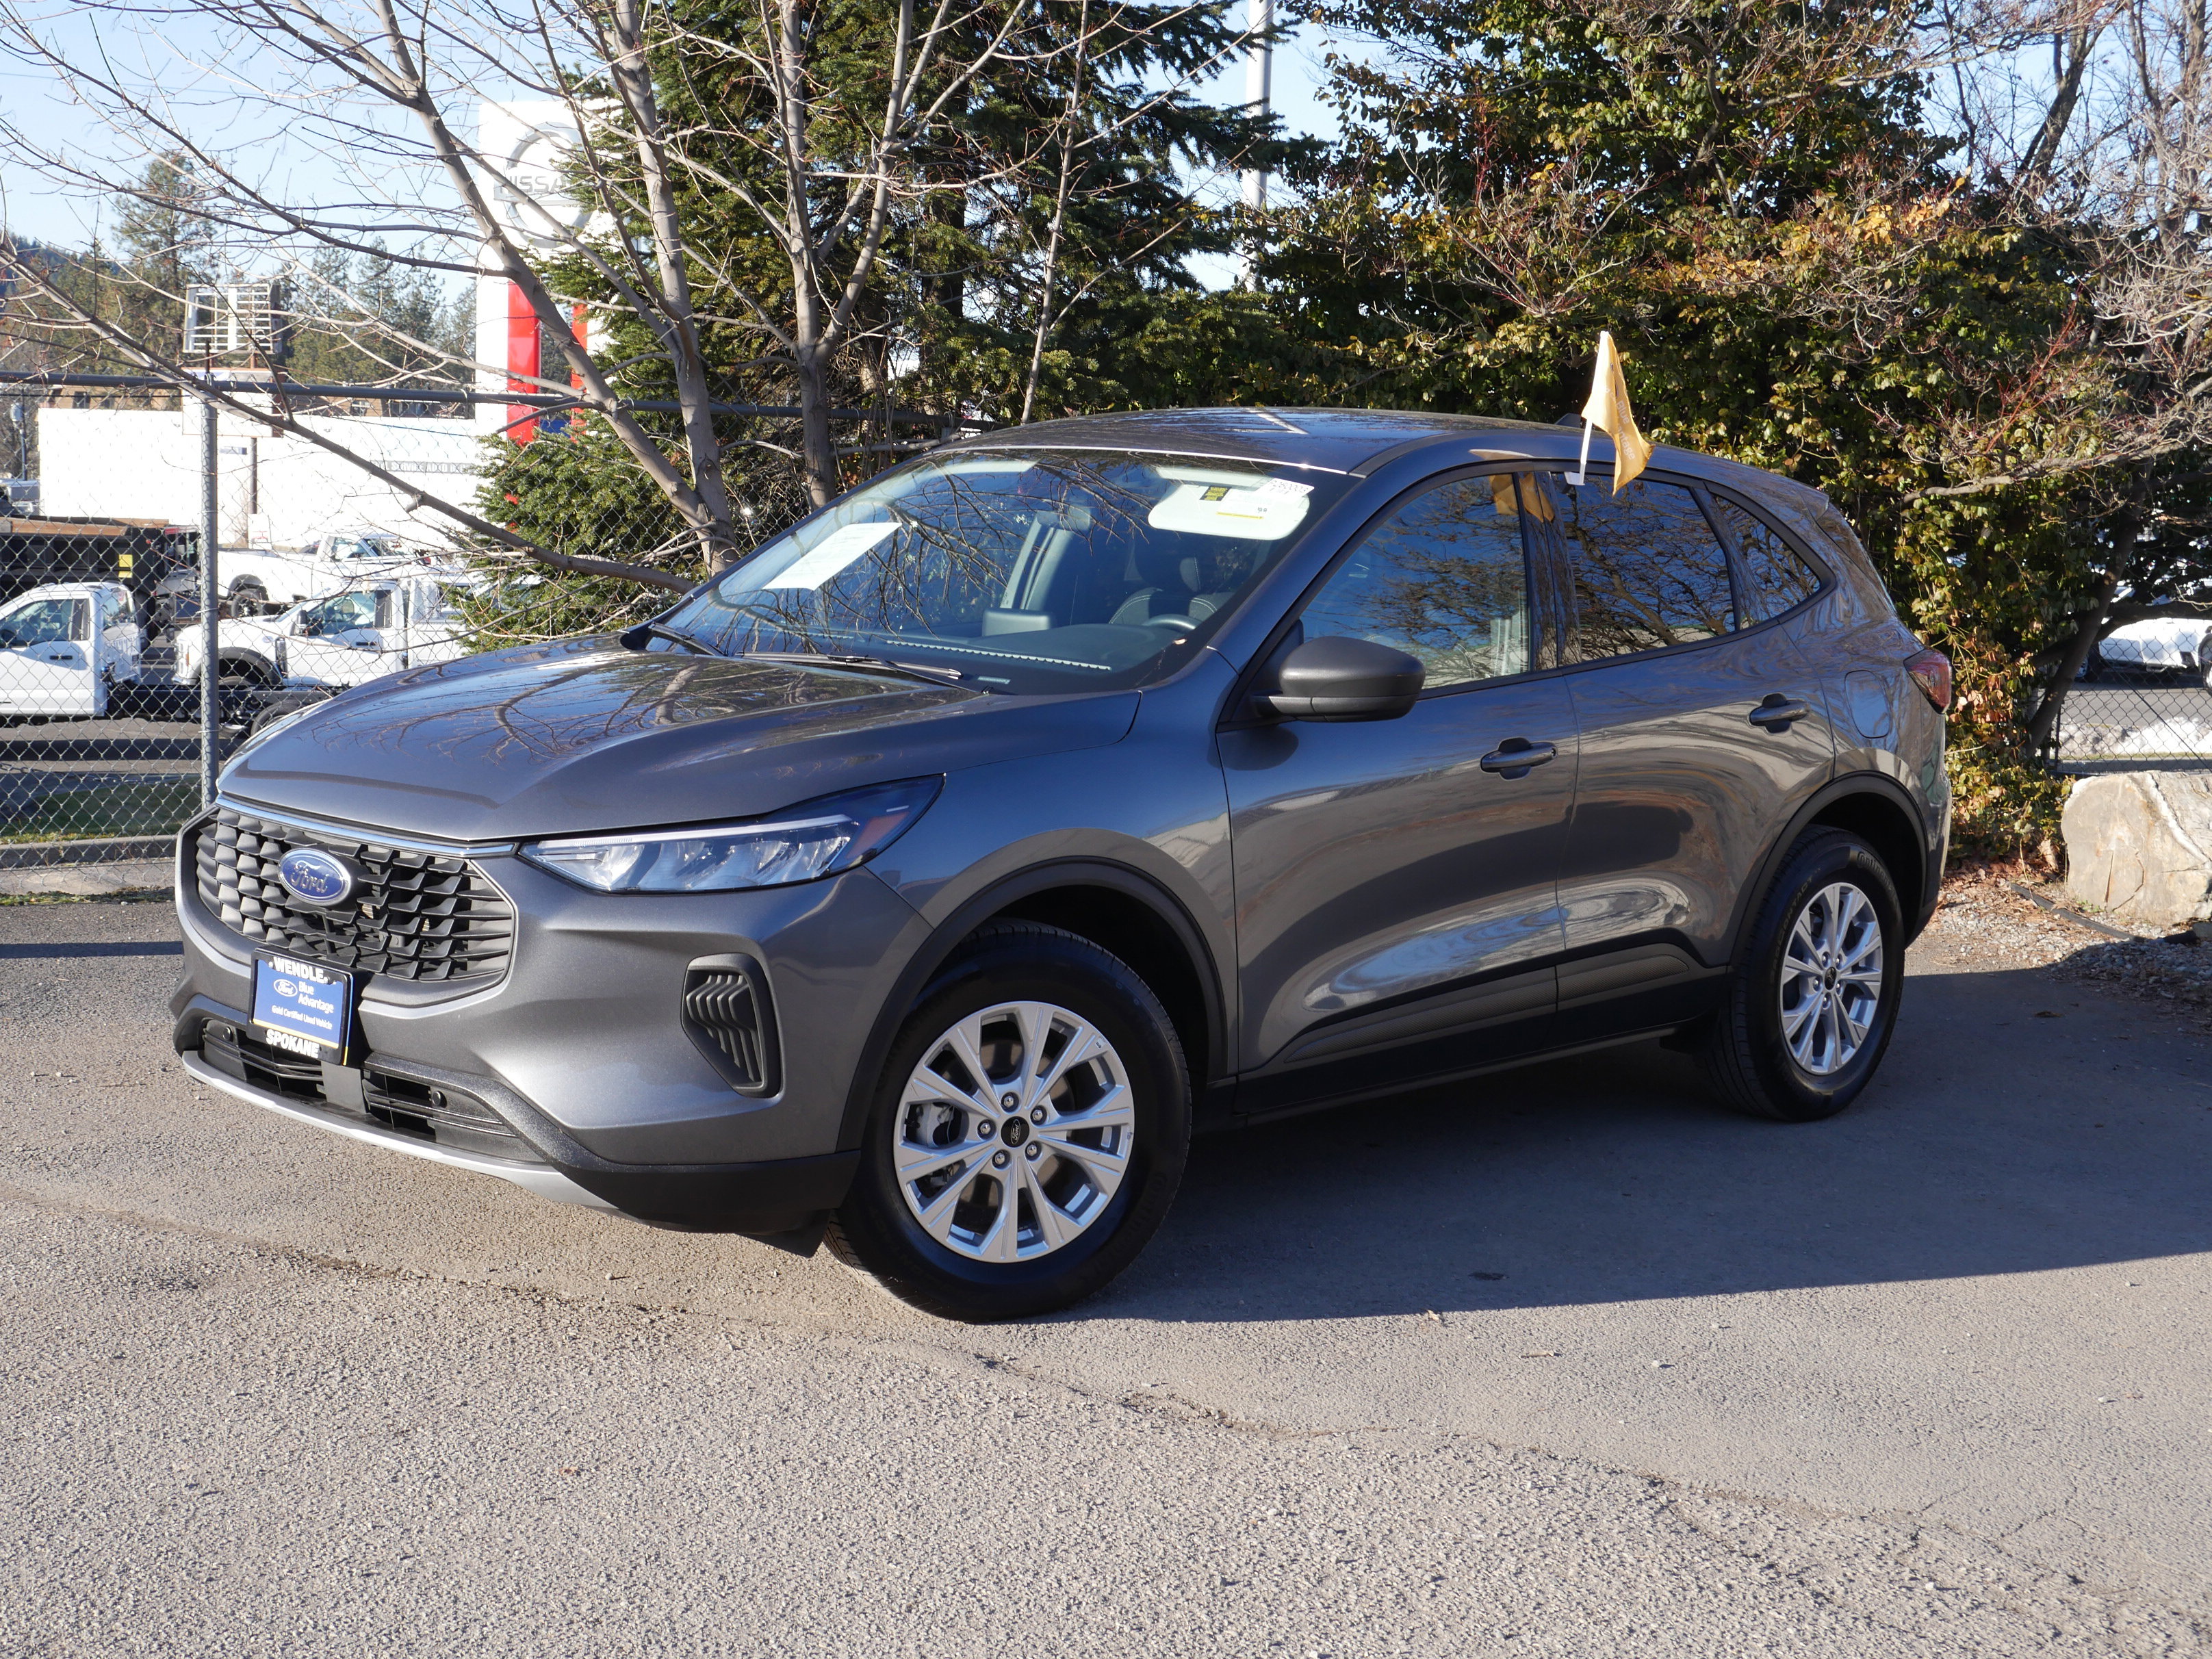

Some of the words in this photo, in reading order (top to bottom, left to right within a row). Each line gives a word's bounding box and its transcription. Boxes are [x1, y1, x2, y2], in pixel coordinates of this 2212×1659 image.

[500, 175, 569, 194] NISSA
[1616, 400, 1630, 424] Blue
[1617, 425, 1636, 461] antage
[291, 860, 330, 894] Ford
[273, 957, 324, 983] WENDLE
[276, 980, 295, 996] Ford
[298, 981, 315, 996] Blue
[272, 1005, 283, 1015] Gold
[298, 994, 334, 1014] Advantage
[266, 1029, 320, 1059] SPOKANE
